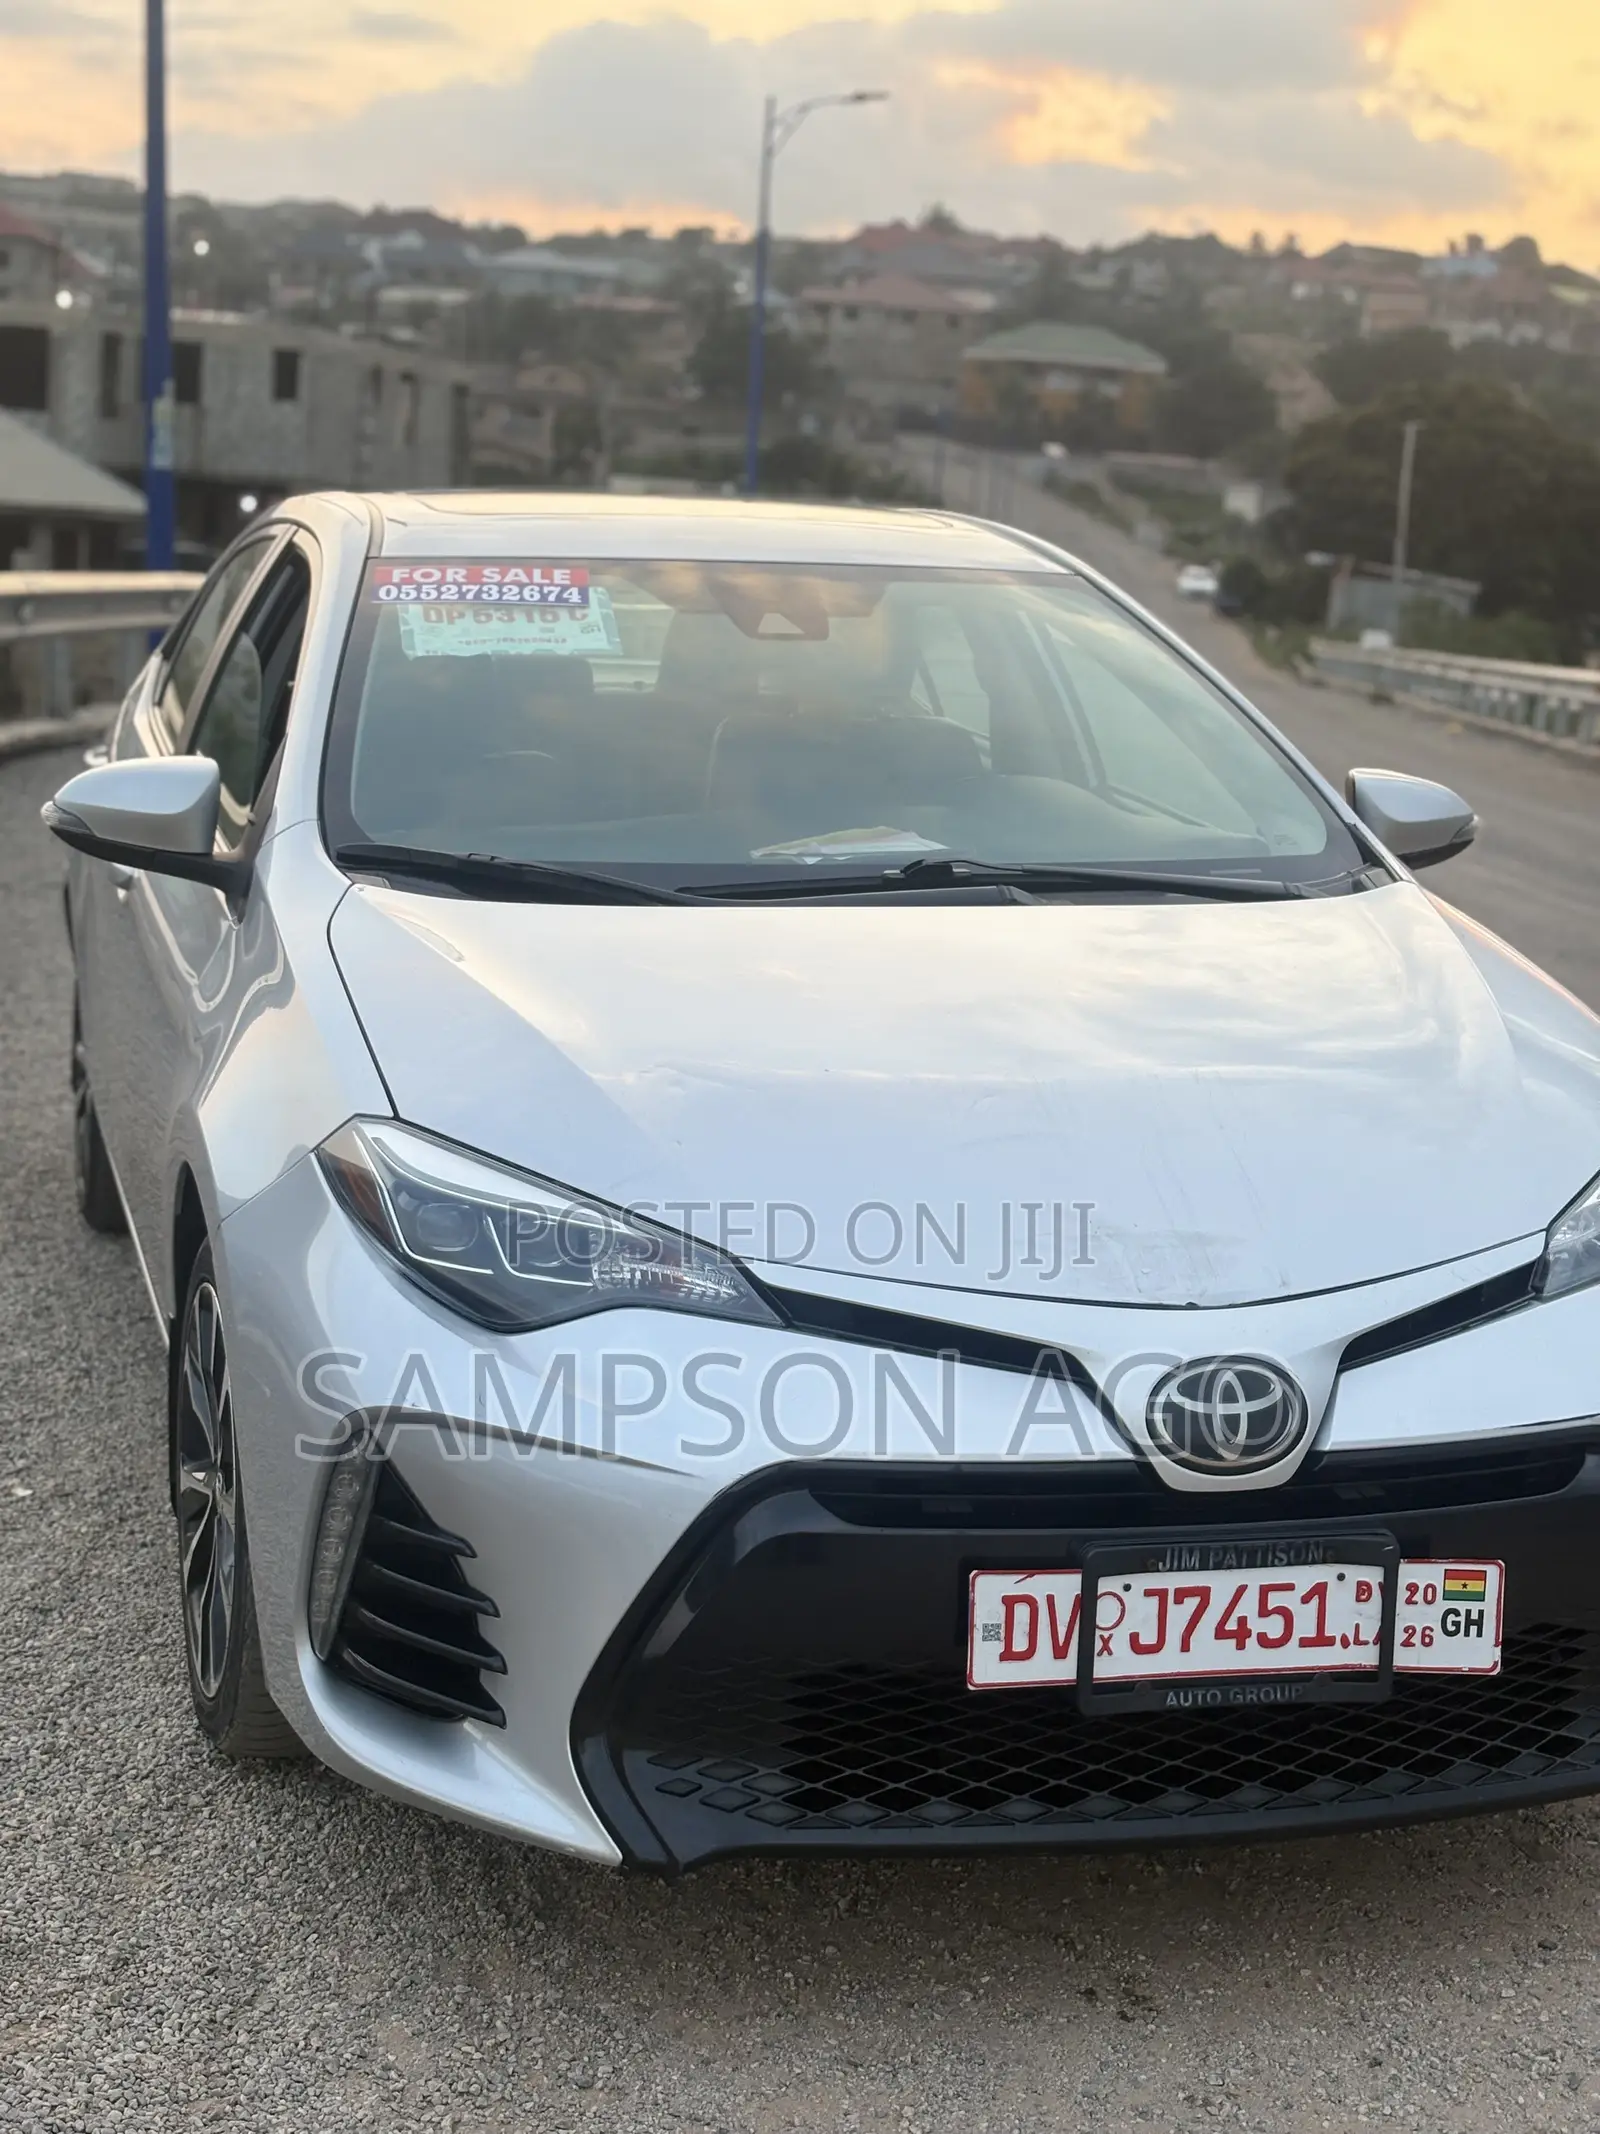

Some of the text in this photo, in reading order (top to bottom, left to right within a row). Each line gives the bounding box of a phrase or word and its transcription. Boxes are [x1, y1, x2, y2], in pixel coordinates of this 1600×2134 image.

[391, 567, 571, 585] FOR SALE
[378, 584, 582, 603] 0552732674
[1158, 1540, 1324, 1572] JIM PATTISON
[1405, 1582, 1437, 1605] 20
[999, 1593, 1081, 1661] DV
[1353, 1622, 1380, 1646] L
[1440, 1607, 1485, 1638] GH
[1400, 1624, 1434, 1647] 26
[1166, 1685, 1302, 1707] AUTO GROUP
